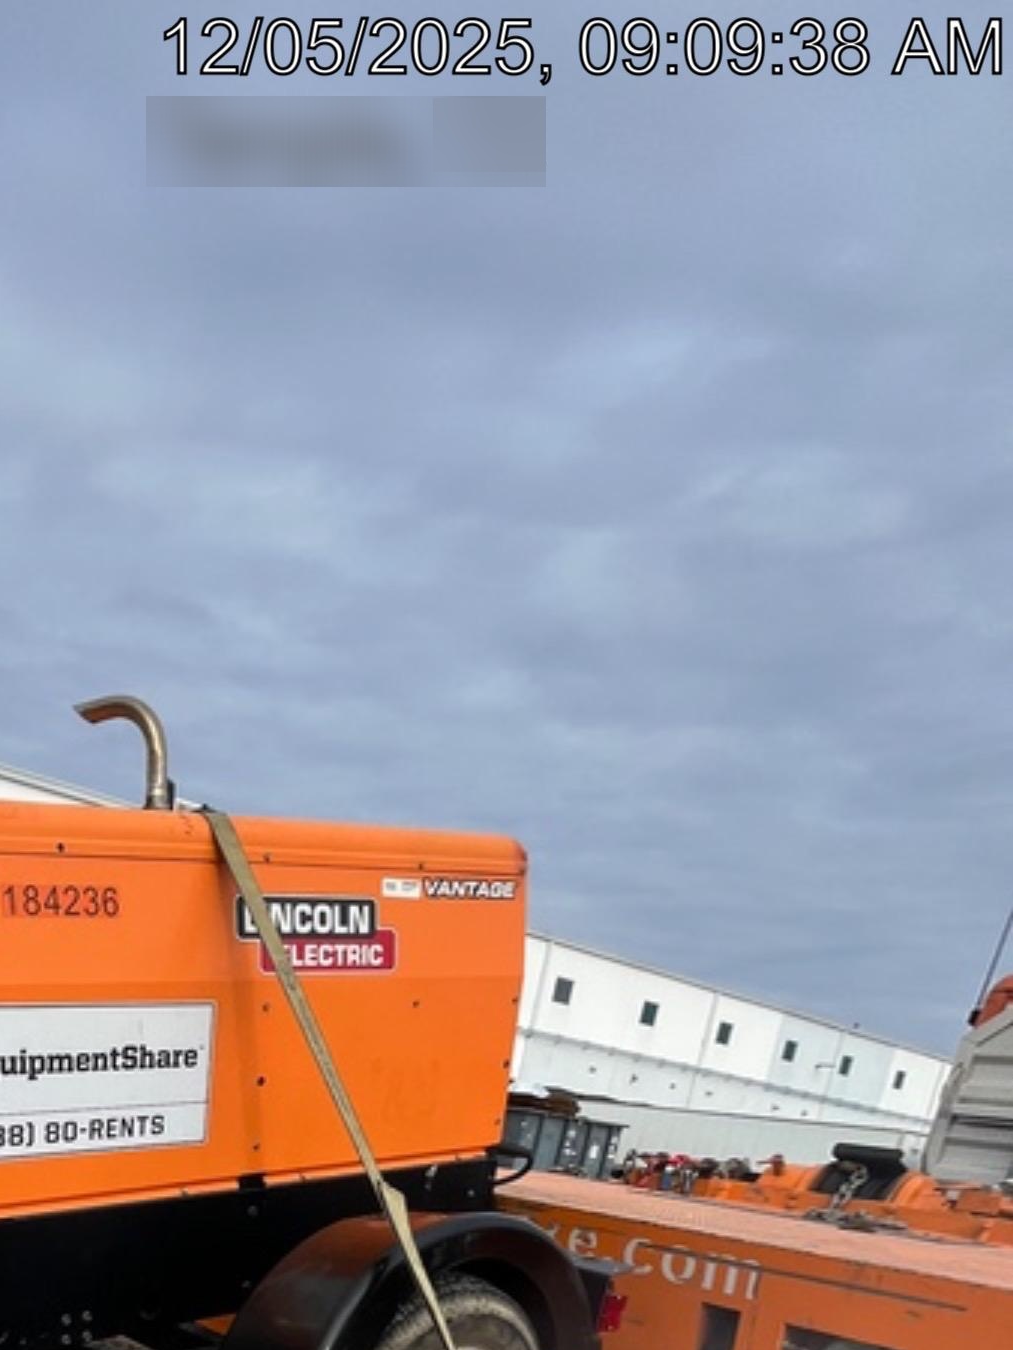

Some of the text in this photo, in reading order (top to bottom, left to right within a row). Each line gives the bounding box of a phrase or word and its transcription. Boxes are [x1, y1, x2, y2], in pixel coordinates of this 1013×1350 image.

[2, 883, 120, 917] 184236
[425, 878, 515, 899] VANTAGE
[244, 902, 370, 935] LNCOLN
[283, 943, 384, 967] LECTRIC
[44, 1114, 166, 1145] 80-RENTS
